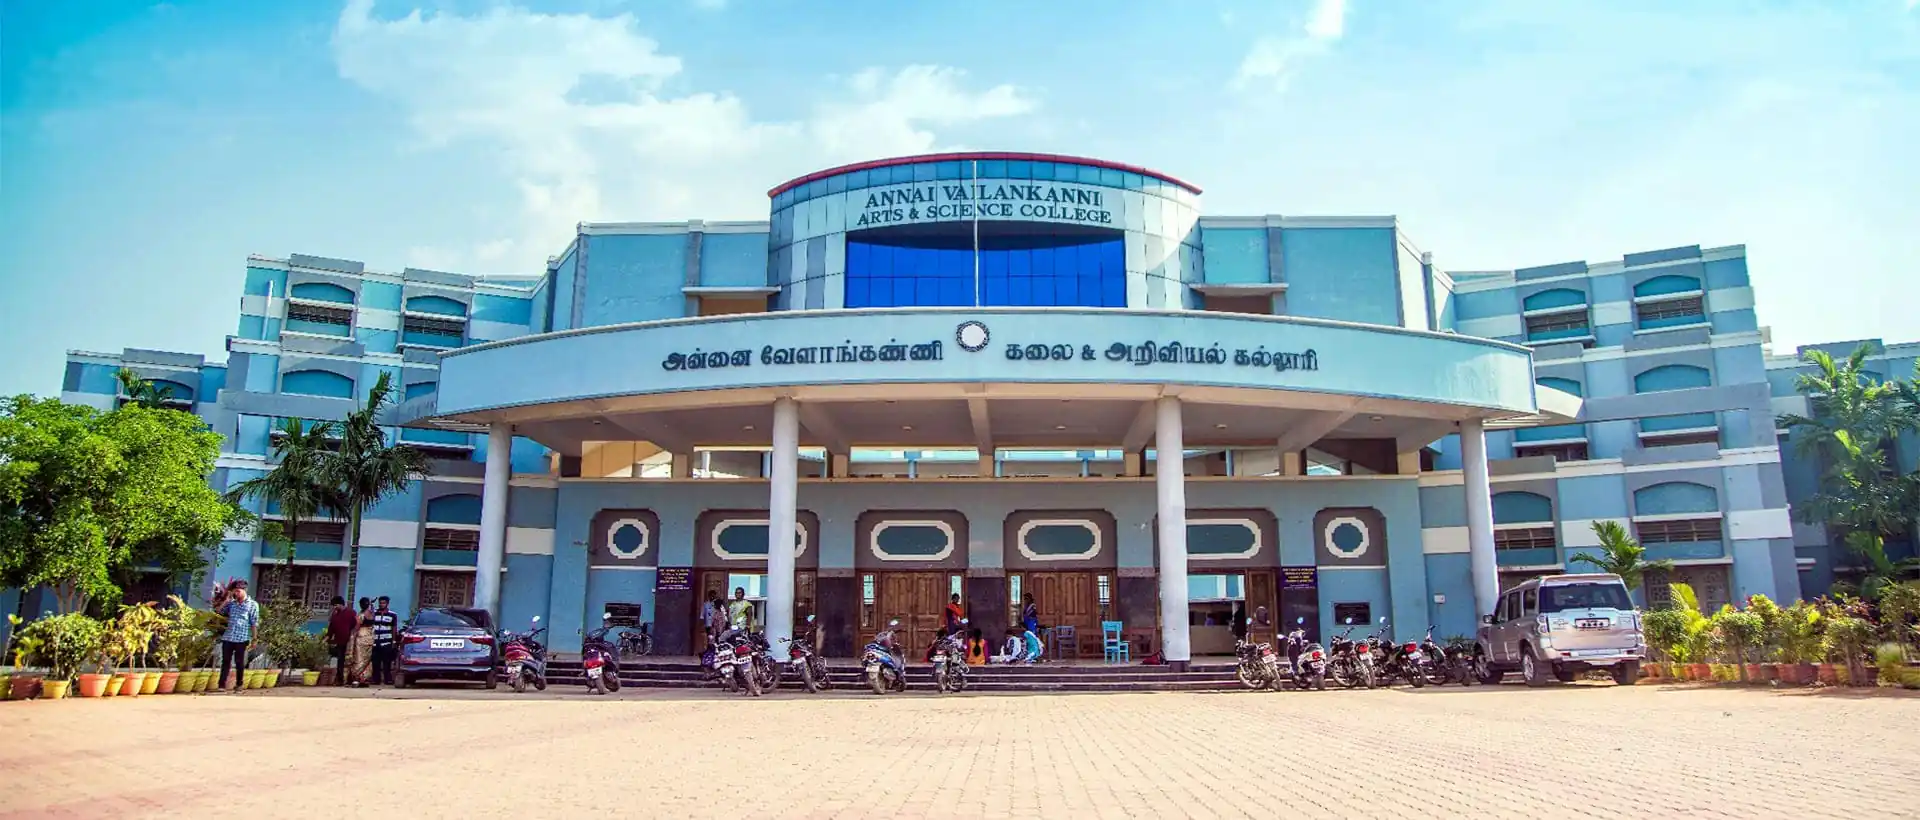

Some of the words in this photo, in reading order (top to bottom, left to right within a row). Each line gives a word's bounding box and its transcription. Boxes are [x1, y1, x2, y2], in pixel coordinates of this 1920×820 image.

[865, 186, 935, 208] ANNAI
[943, 184, 1100, 206] VAILANKANNI
[857, 208, 903, 225] ARTS
[909, 207, 920, 220] &
[926, 203, 1013, 220] SCIENCE
[1020, 203, 1112, 224] COLLEGE
[662, 347, 752, 371] அன்னை
[761, 338, 944, 365] வேளாங்கண்ணி
[1005, 343, 1074, 361] கலை
[1081, 344, 1097, 361] &
[1104, 340, 1227, 366] அறிவியல்
[1233, 344, 1319, 372] கல்லூரி
